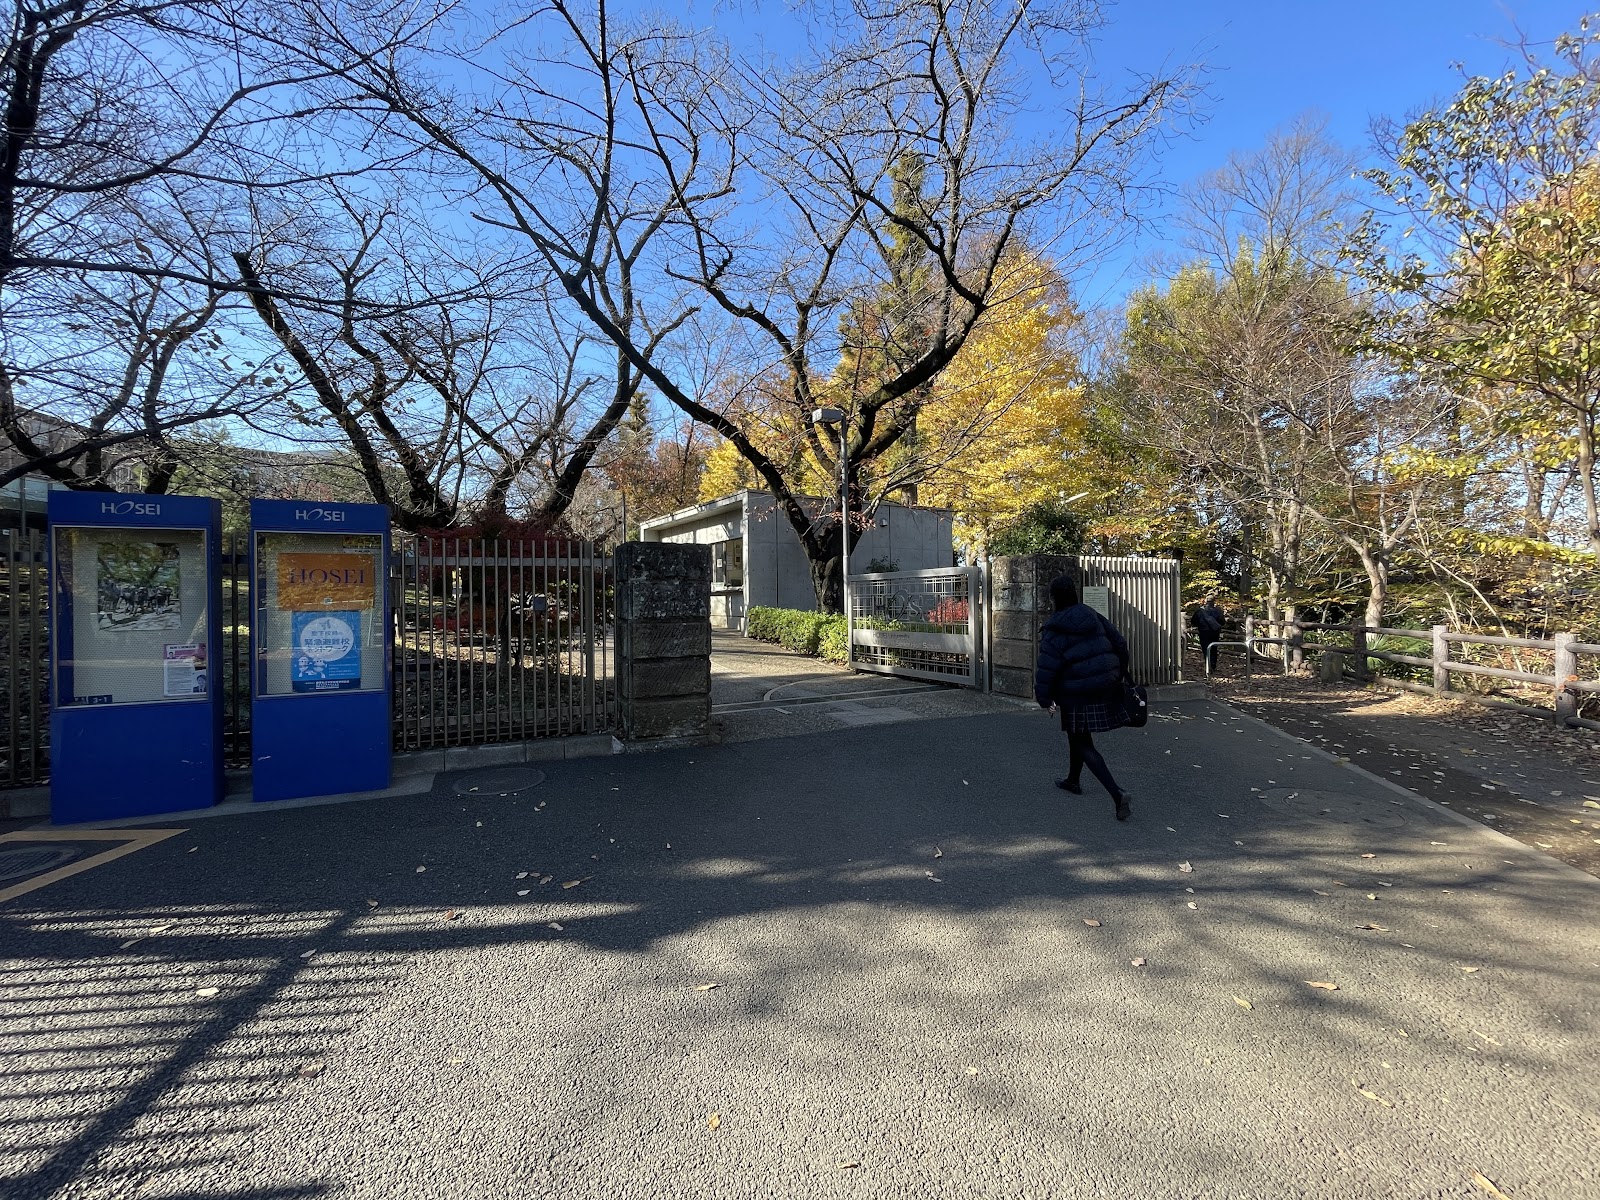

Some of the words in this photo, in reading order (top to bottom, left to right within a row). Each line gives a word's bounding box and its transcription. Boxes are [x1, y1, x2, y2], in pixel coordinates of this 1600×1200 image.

[101, 501, 160, 515] HOSEI
[295, 508, 345, 521] HOSEI
[290, 568, 365, 584] HOSEI
